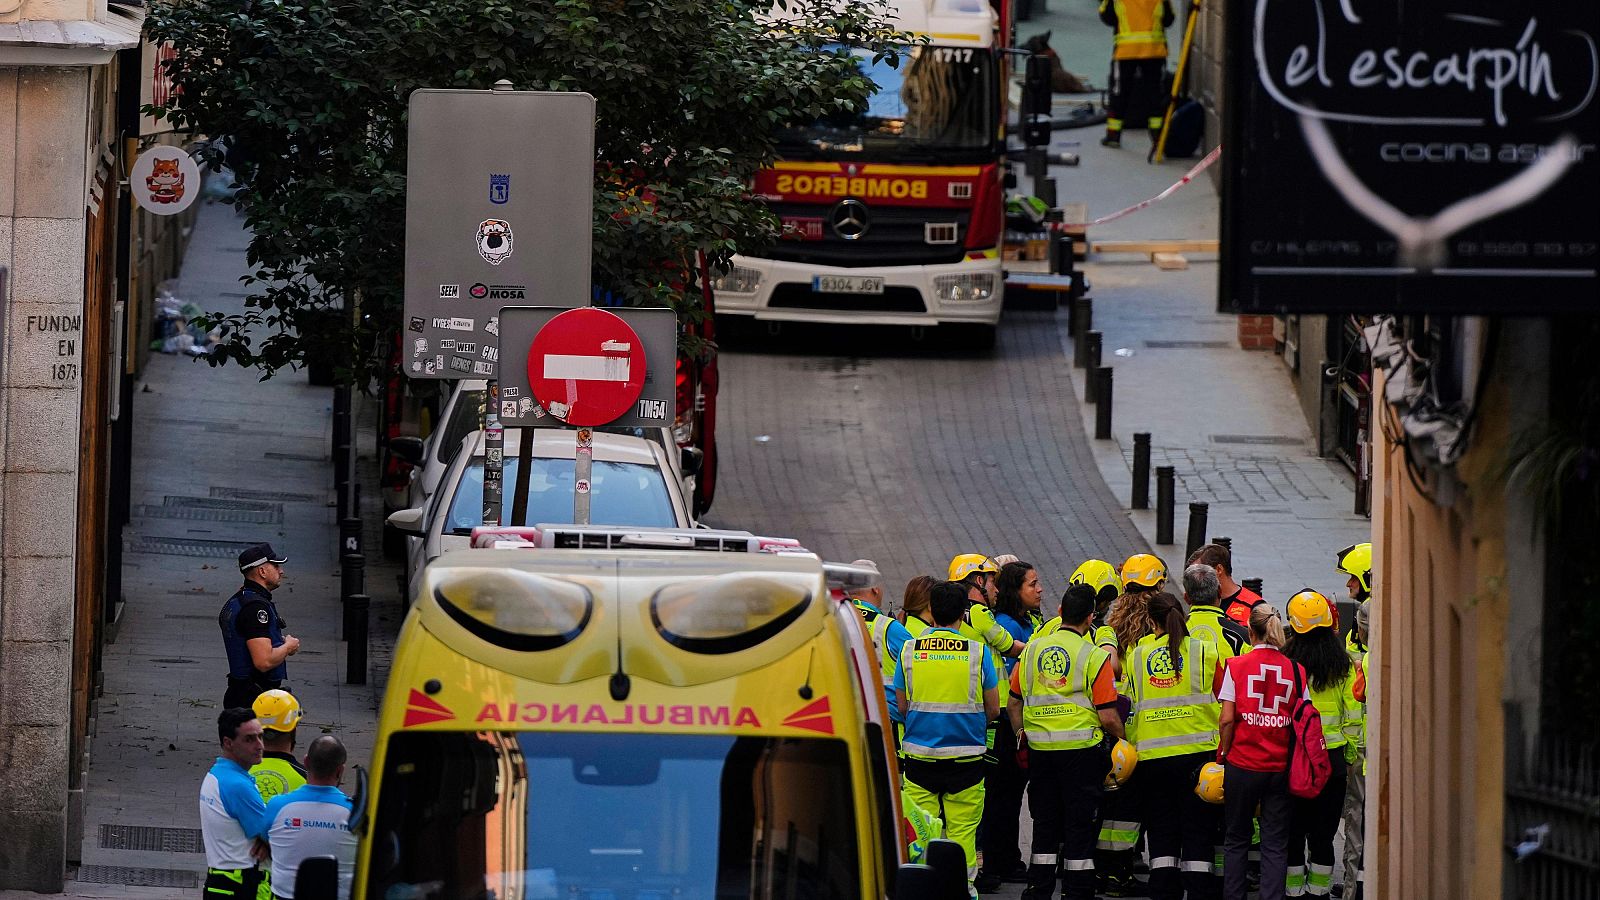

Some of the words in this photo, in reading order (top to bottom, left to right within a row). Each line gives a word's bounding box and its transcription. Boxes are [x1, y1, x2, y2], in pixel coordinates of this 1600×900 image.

[1349, 16, 1560, 126] escarpín
[1380, 142, 1492, 163] cocina
[440, 286, 458, 297] SEEM
[821, 278, 853, 293] 9304
[490, 291, 524, 299] MOSA
[58, 340, 75, 356] EN
[52, 364, 77, 380] 1873
[639, 400, 666, 419] TM54
[920, 638, 963, 650] MEDICO
[1146, 711, 1193, 720] PSICOSOCIAL
[303, 819, 336, 829] SUMMA
